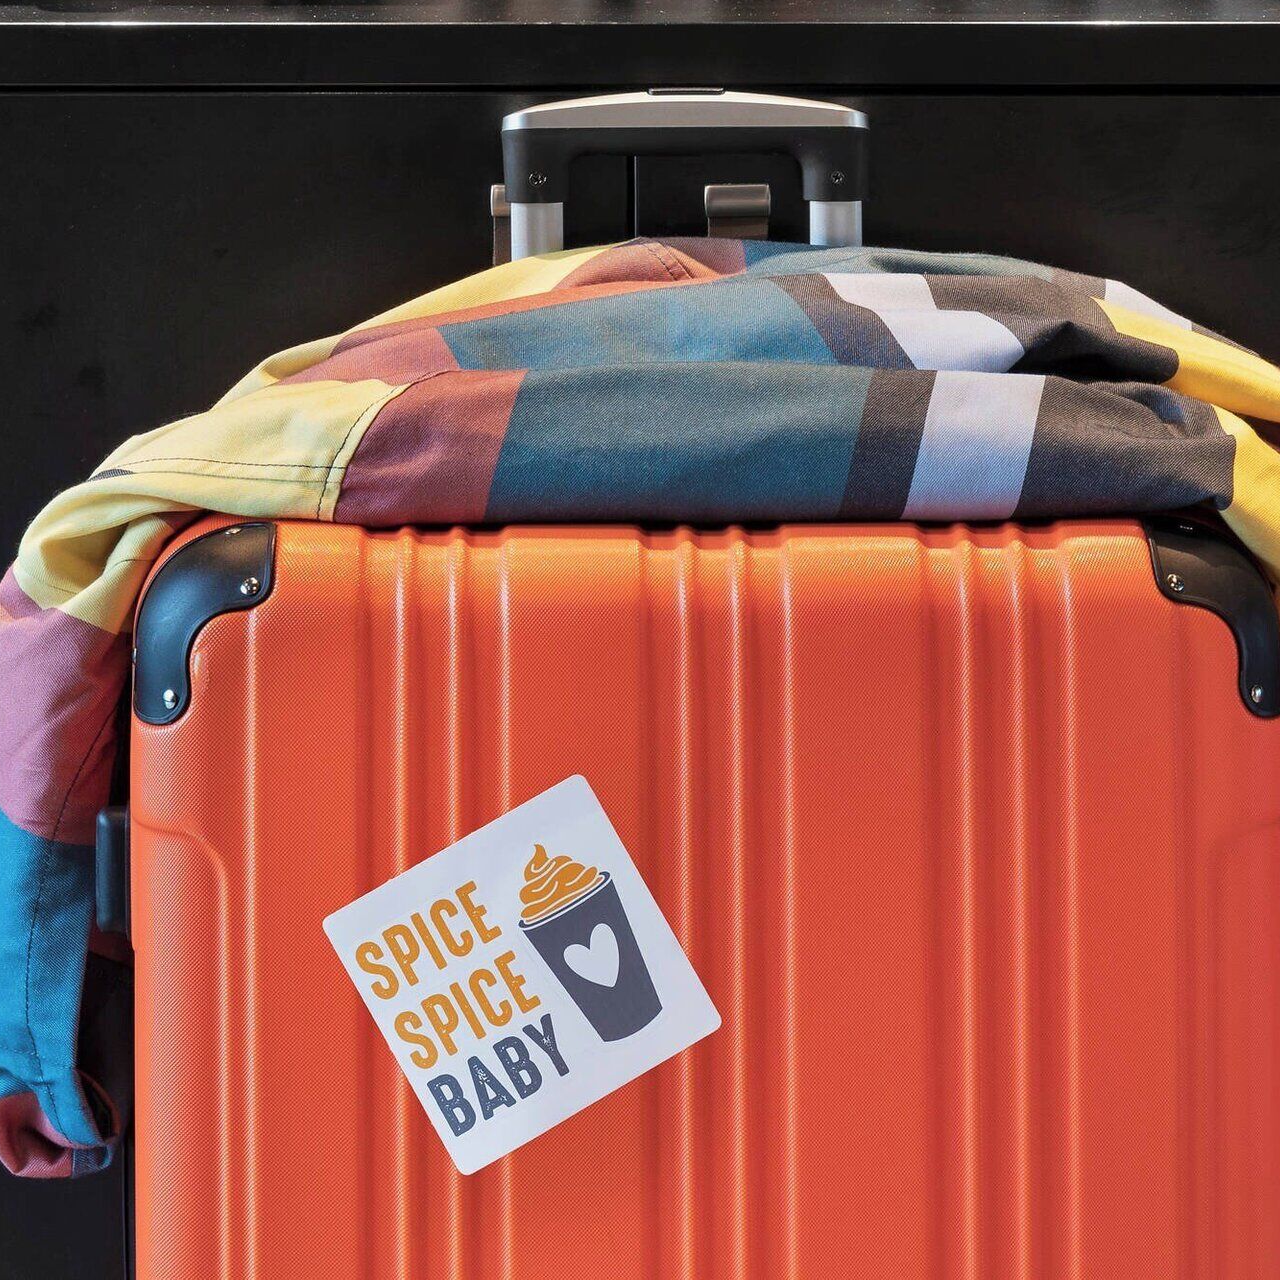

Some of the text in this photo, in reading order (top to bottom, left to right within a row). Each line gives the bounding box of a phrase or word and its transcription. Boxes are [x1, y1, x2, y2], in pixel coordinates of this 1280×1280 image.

[355, 880, 502, 1000] SPICE
[394, 950, 541, 1070] SPICE
[427, 1013, 570, 1137] BABY
